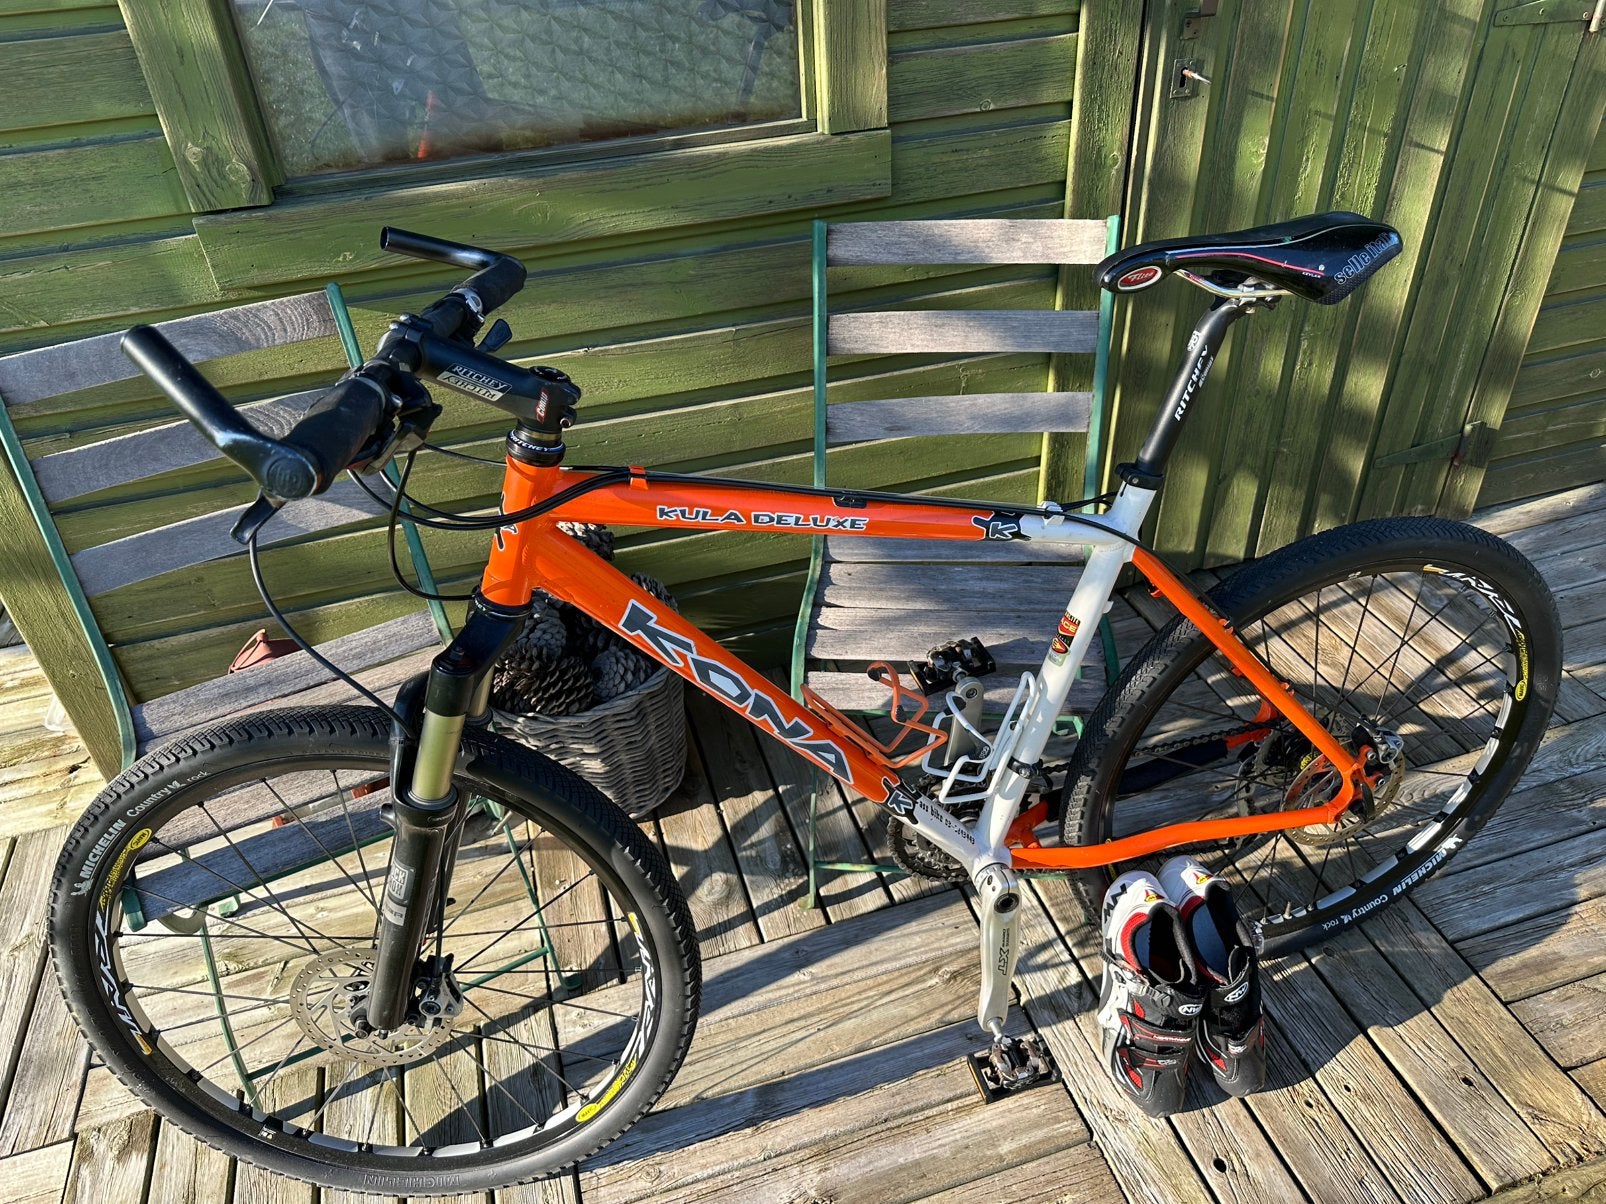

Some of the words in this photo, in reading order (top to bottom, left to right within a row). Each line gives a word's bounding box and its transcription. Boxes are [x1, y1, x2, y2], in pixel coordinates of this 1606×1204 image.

[1334, 252, 1370, 285] selle
[452, 365, 508, 391] RITCHEY
[1174, 344, 1209, 422] RITCHEY
[510, 434, 550, 452] RITCHEY
[656, 505, 745, 525] KULA
[751, 511, 869, 531] DELUXE
[618, 598, 855, 784] KONA
[80, 818, 127, 879] MICHELIN
[126, 785, 174, 818] Country
[186, 771, 210, 783] rock
[1392, 847, 1447, 896] MICHELIN
[1350, 893, 1389, 921] Country
[1321, 918, 1340, 931] rock
[997, 947, 1010, 976] XT
